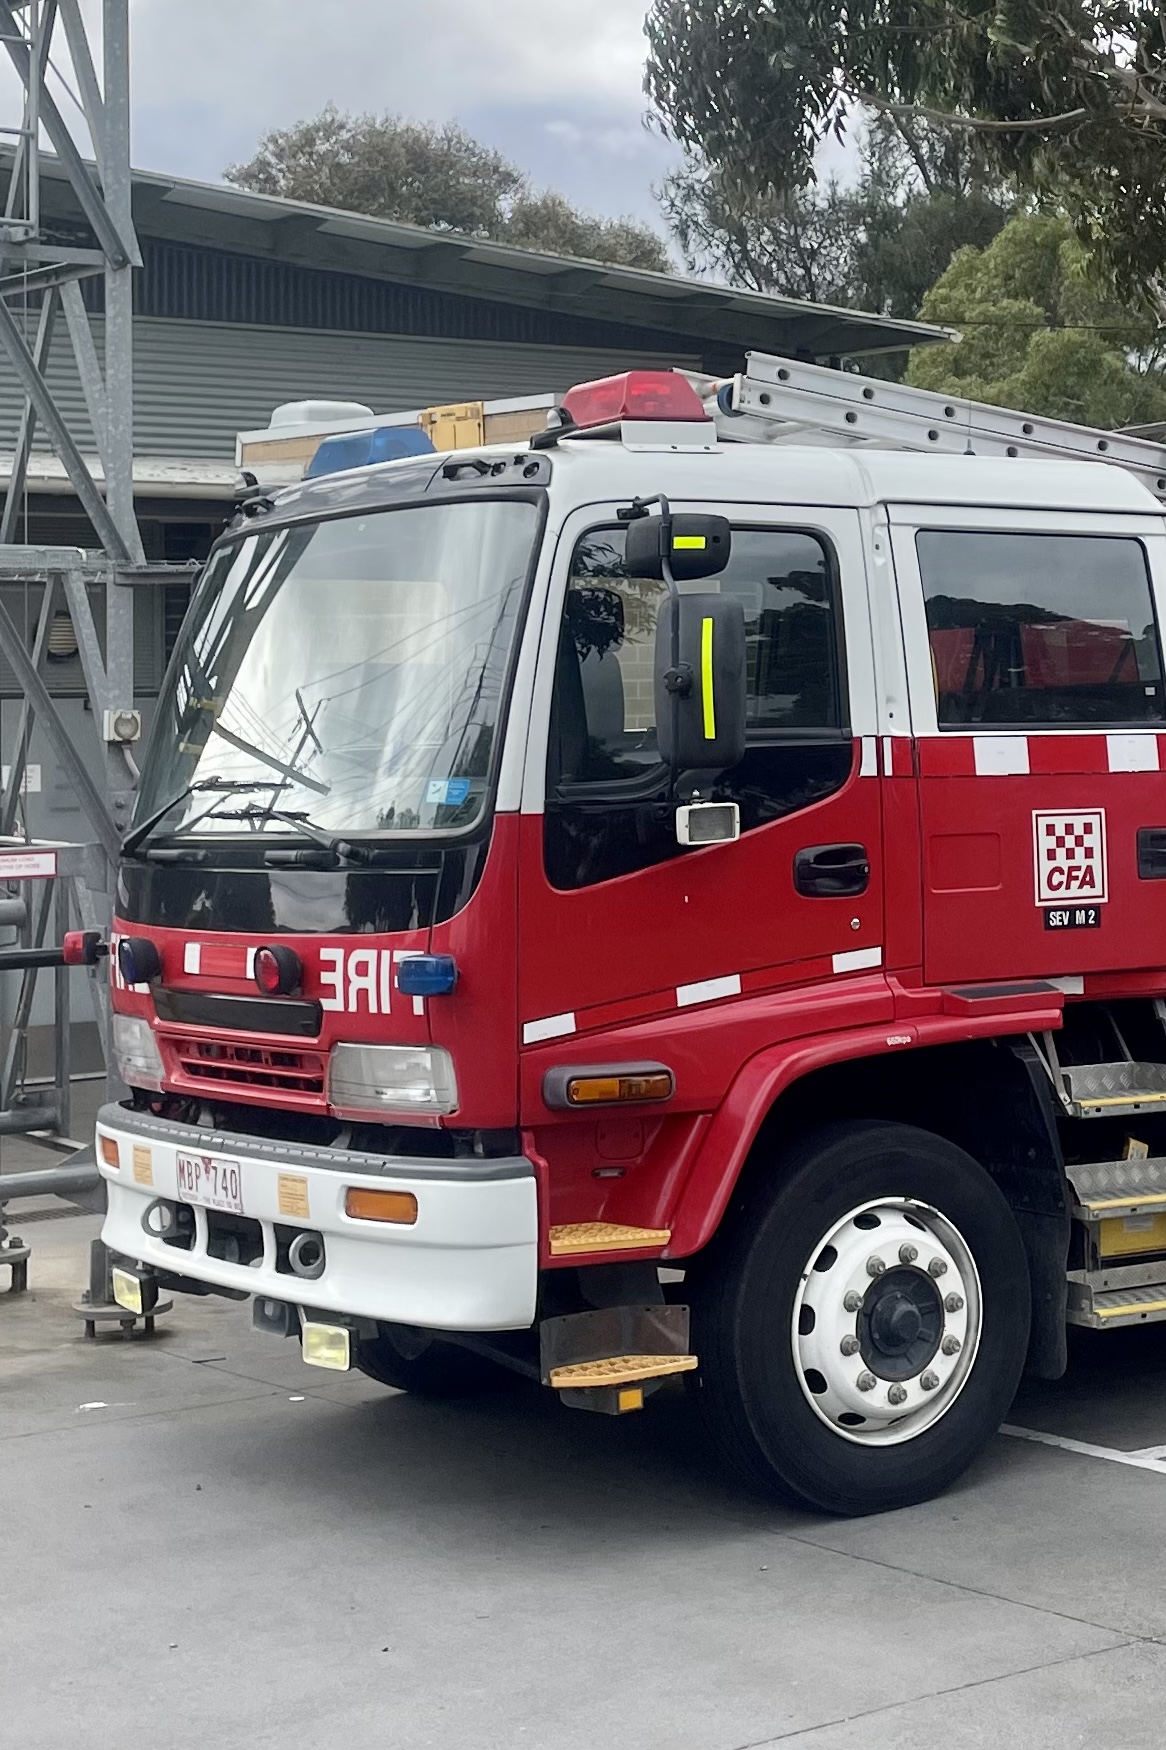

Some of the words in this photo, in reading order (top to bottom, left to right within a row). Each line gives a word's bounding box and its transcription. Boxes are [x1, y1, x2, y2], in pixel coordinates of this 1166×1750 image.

[1046, 865, 1096, 891] CFA
[1049, 910, 1070, 927] SEV
[1075, 909, 1086, 925] M
[1088, 909, 1096, 924] 2
[178, 1158, 201, 1193] MBP
[211, 1165, 238, 1200] 740
